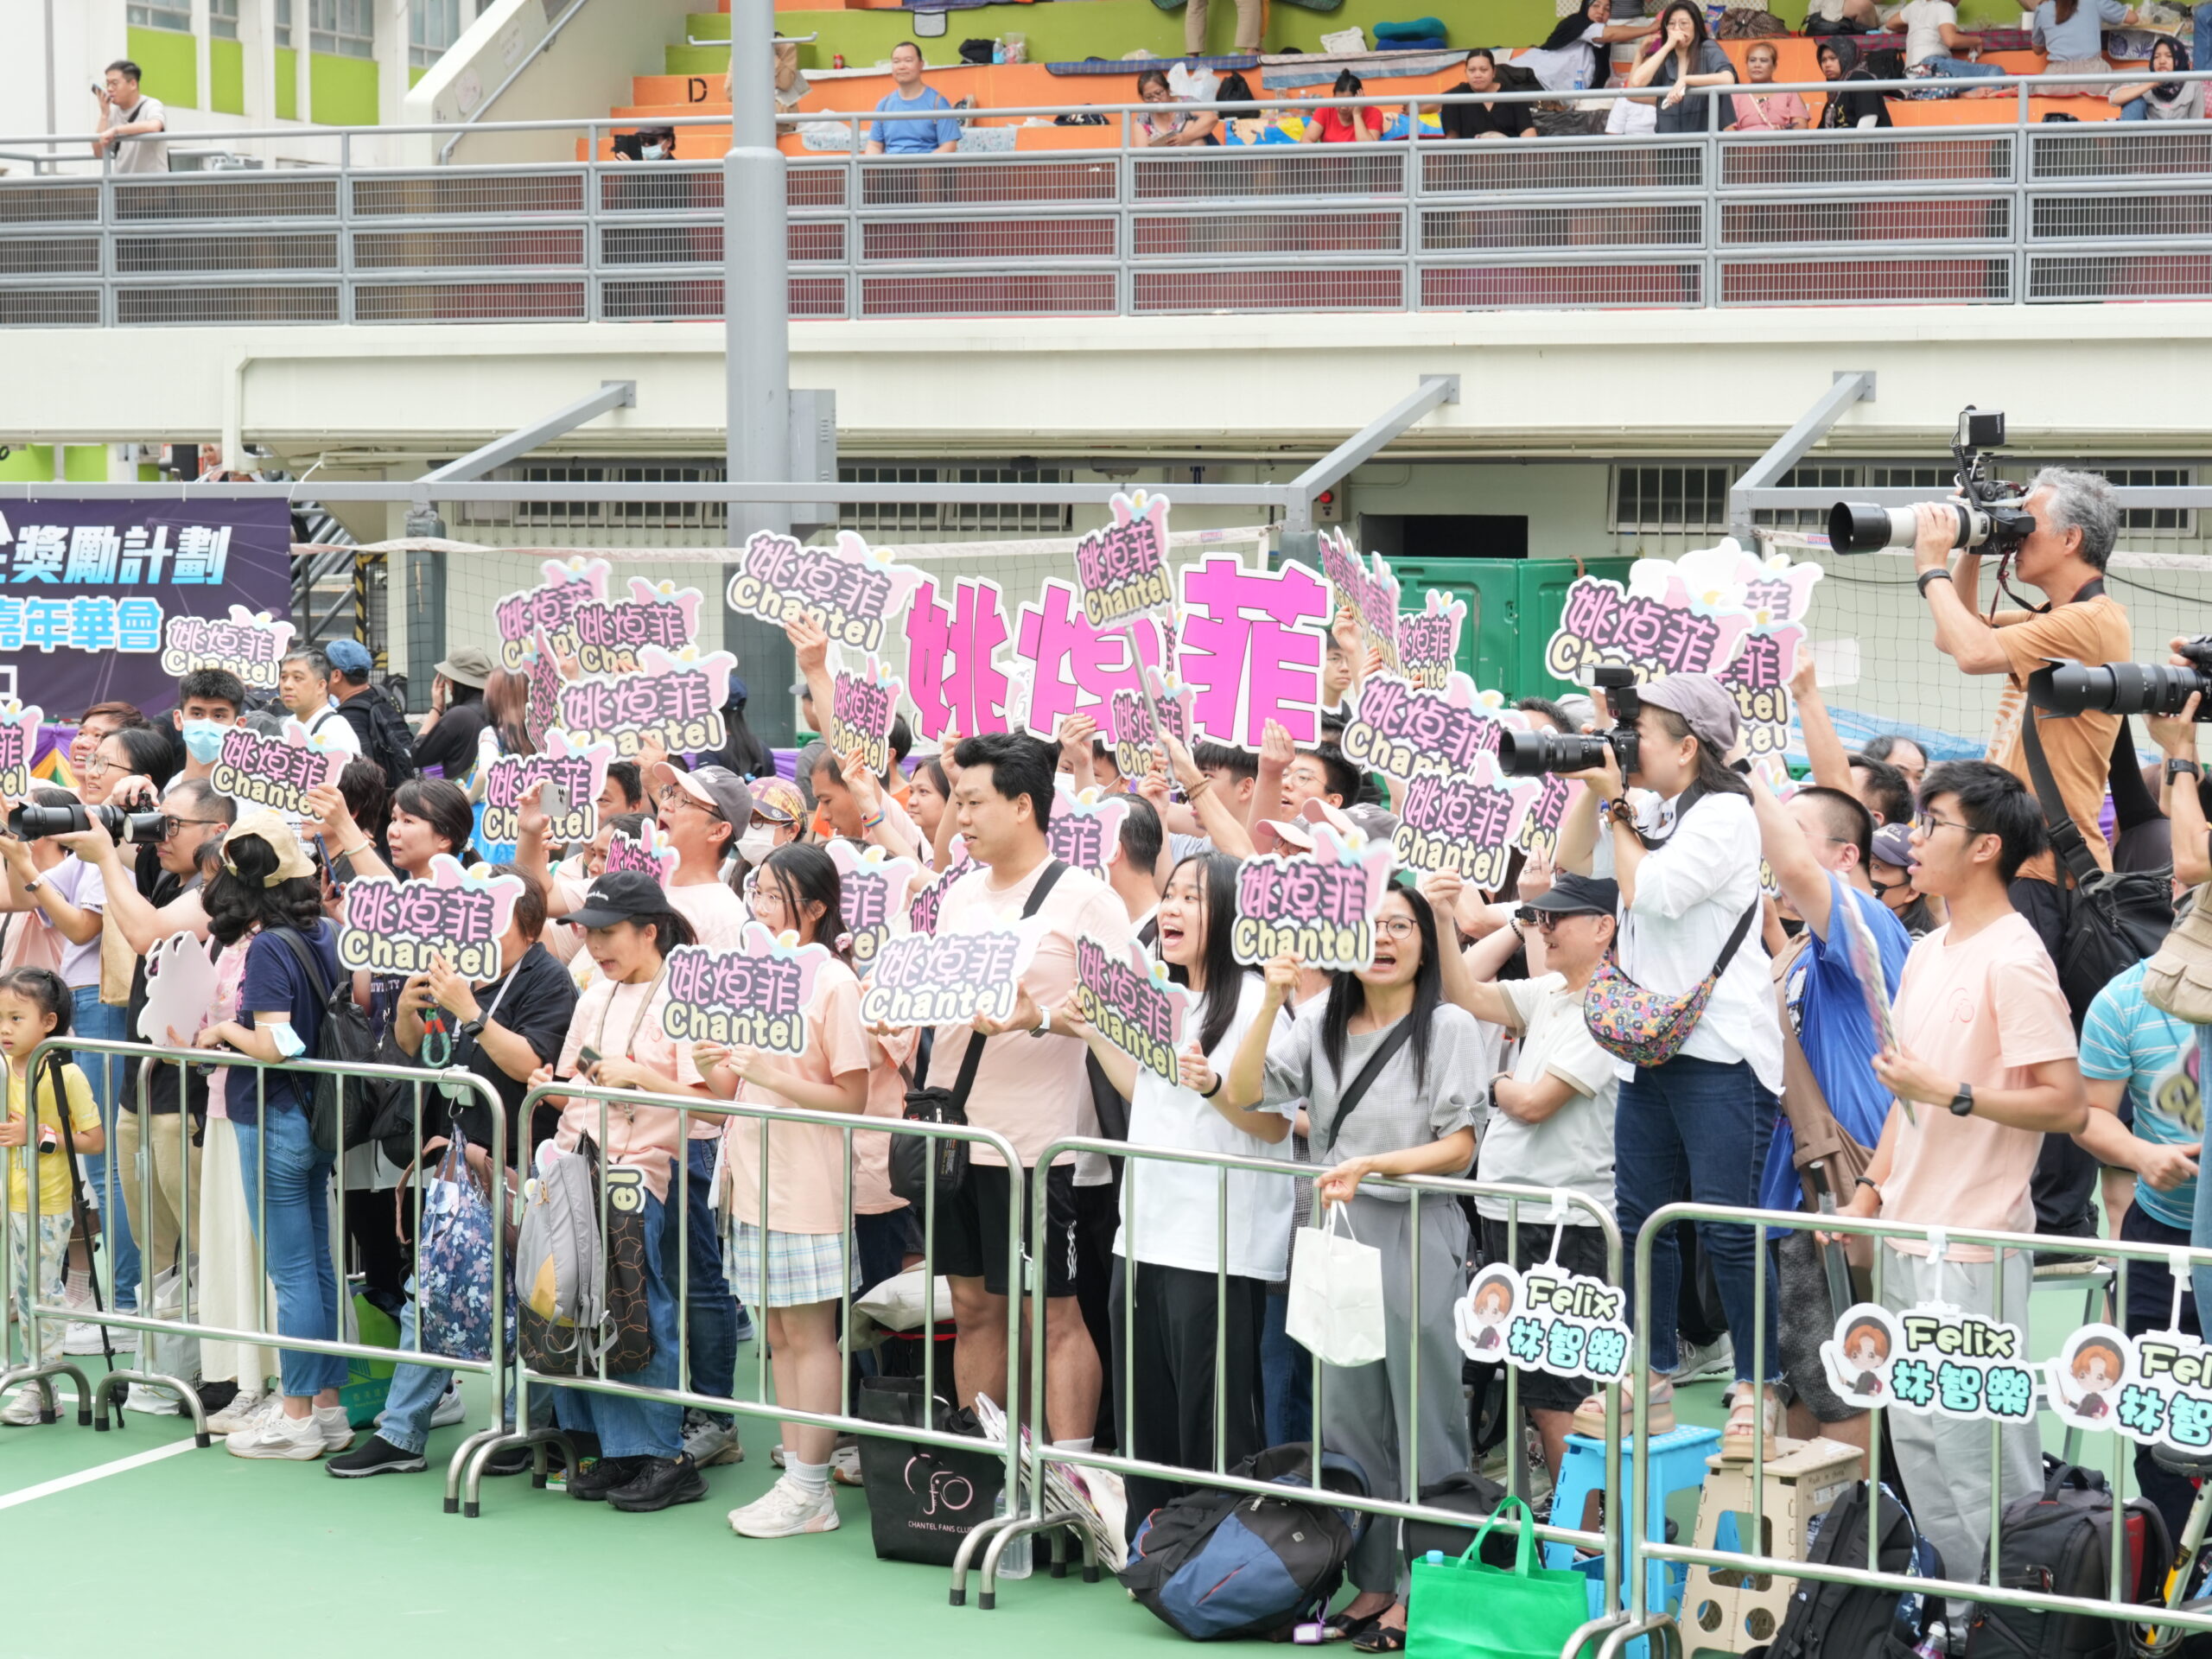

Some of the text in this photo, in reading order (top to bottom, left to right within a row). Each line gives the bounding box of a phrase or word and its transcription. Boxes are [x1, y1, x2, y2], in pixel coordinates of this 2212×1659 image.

[688, 77, 708, 103] D
[746, 535, 892, 620] 姚焯菲
[1077, 518, 1162, 592] 姚焯菲
[574, 602, 687, 646] 姚焯菲
[731, 575, 883, 652] Chantel
[1084, 565, 1173, 626] Chantel
[170, 620, 277, 663] 姚焯菲
[907, 560, 1327, 747] 姚焯菲
[1566, 581, 1719, 676] 姚焯菲
[562, 670, 710, 732] 姚焯菲
[835, 669, 889, 738] 姚焯菲
[223, 727, 330, 791] 姚焯菲
[481, 805, 594, 842] Chtel
[1403, 773, 1514, 849] 姚焯菲
[1393, 823, 1506, 888] Chantel
[346, 880, 494, 944] 姚焯菲
[1238, 861, 1370, 928] 姚焯菲
[341, 928, 499, 979] Chantel
[877, 930, 1020, 988] 姚焯菲
[1234, 917, 1370, 964] Chantel
[669, 950, 802, 1015] 姚焯菲
[862, 981, 1014, 1026] Chantel
[1077, 936, 1172, 1044] 姚焯菲
[663, 999, 804, 1054] Chantel
[1077, 983, 1179, 1088] Chantel
[1526, 1276, 1620, 1321] Felix
[1507, 1316, 1627, 1377] 林智樂
[1904, 1316, 2014, 1358] Felix
[1890, 1358, 2032, 1418] 林智樂
[907, 1520, 938, 1532] CHANTEL
[938, 1523, 956, 1533] FANS
